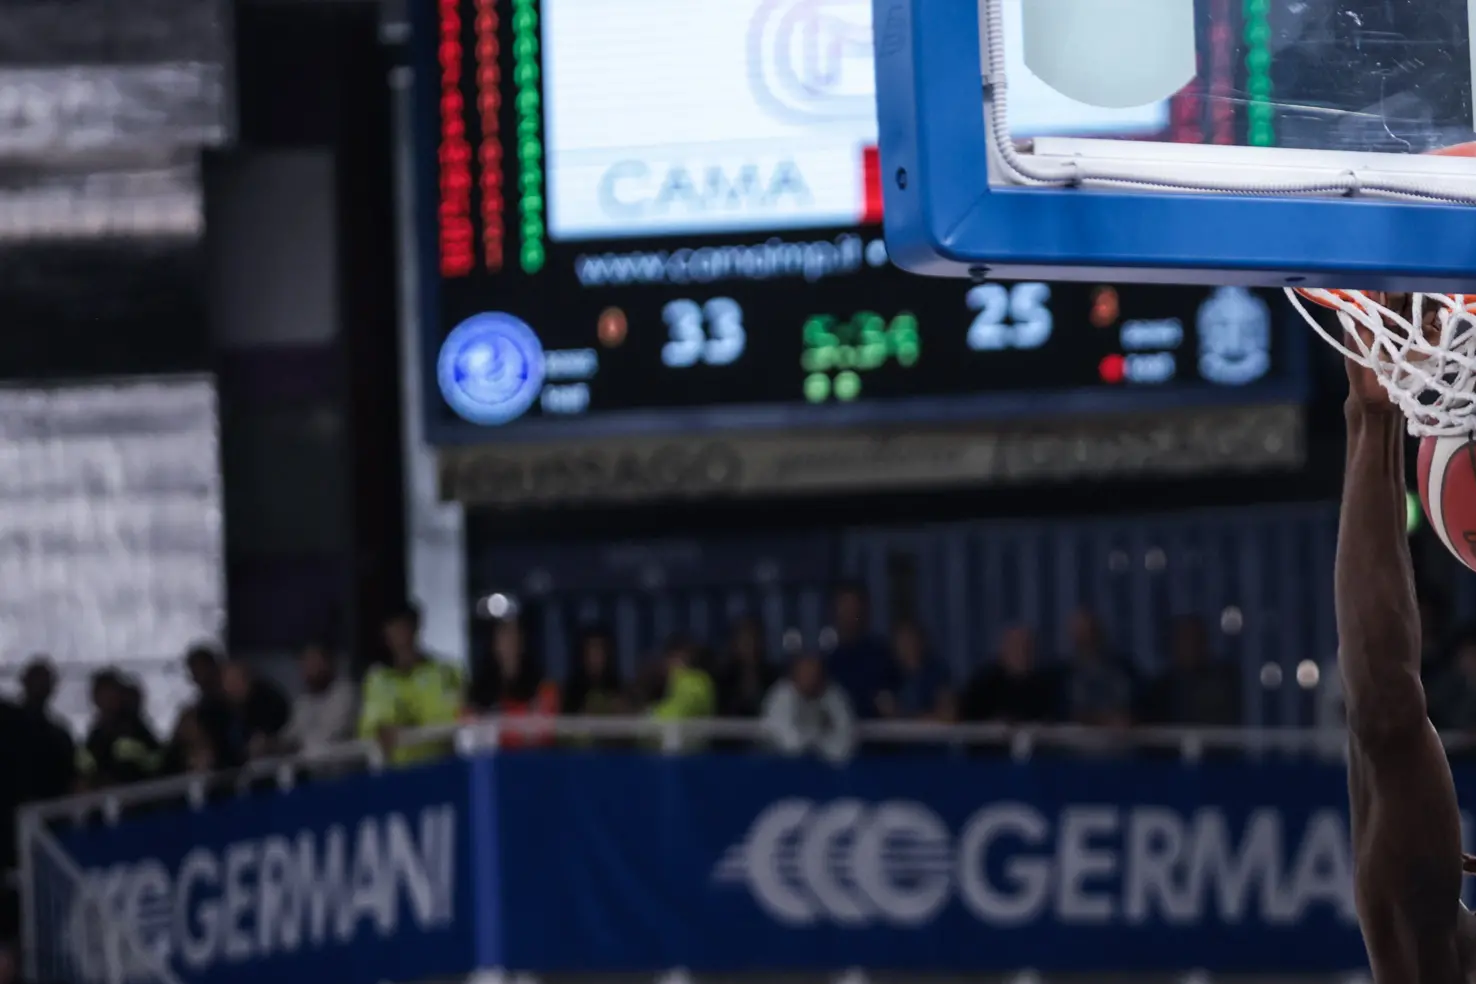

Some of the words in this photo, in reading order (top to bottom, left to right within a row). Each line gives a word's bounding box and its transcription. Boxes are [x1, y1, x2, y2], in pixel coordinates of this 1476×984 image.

[597, 158, 816, 220] CAMA
[661, 296, 747, 367] 33
[966, 283, 1053, 350] 25
[177, 803, 457, 967] GERMANI
